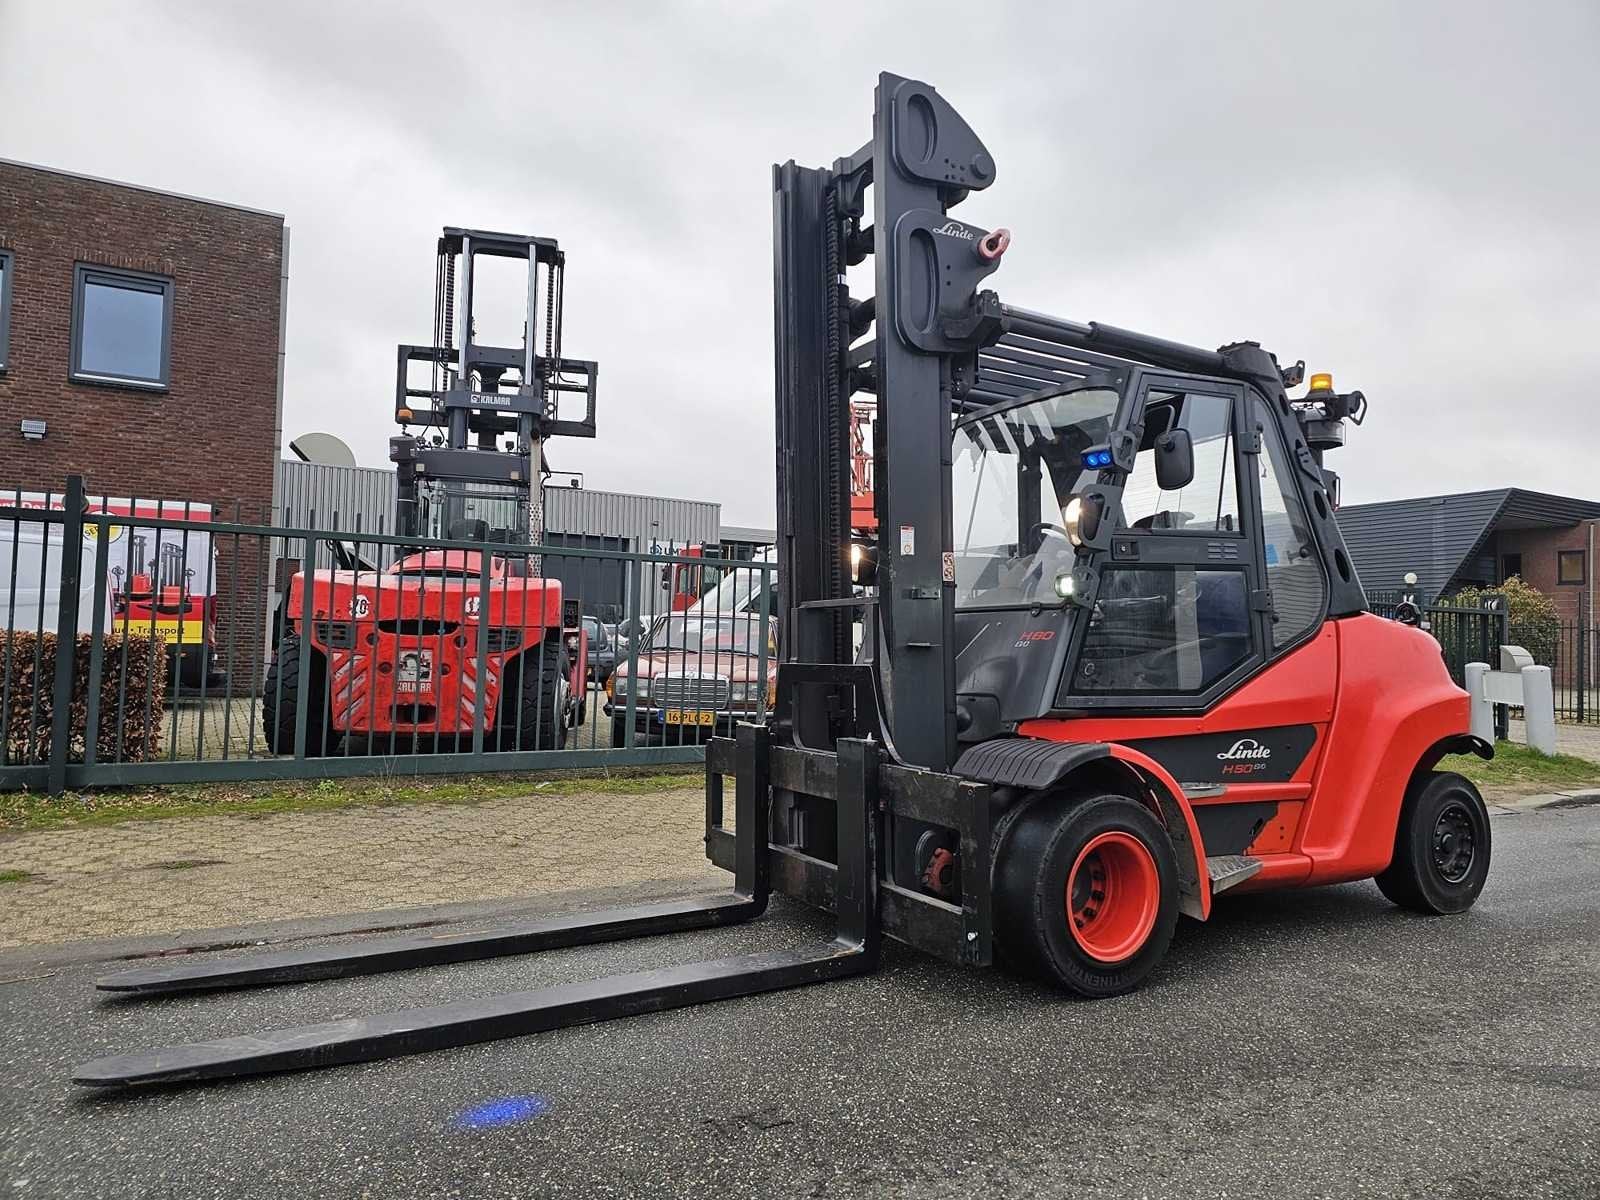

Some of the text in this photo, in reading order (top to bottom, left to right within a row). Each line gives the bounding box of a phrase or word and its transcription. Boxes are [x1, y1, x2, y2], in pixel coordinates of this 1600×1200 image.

[932, 222, 974, 241] Linde
[480, 395, 511, 406] KALMAR
[136, 626, 185, 637] Transpot
[1216, 738, 1272, 760] Linde
